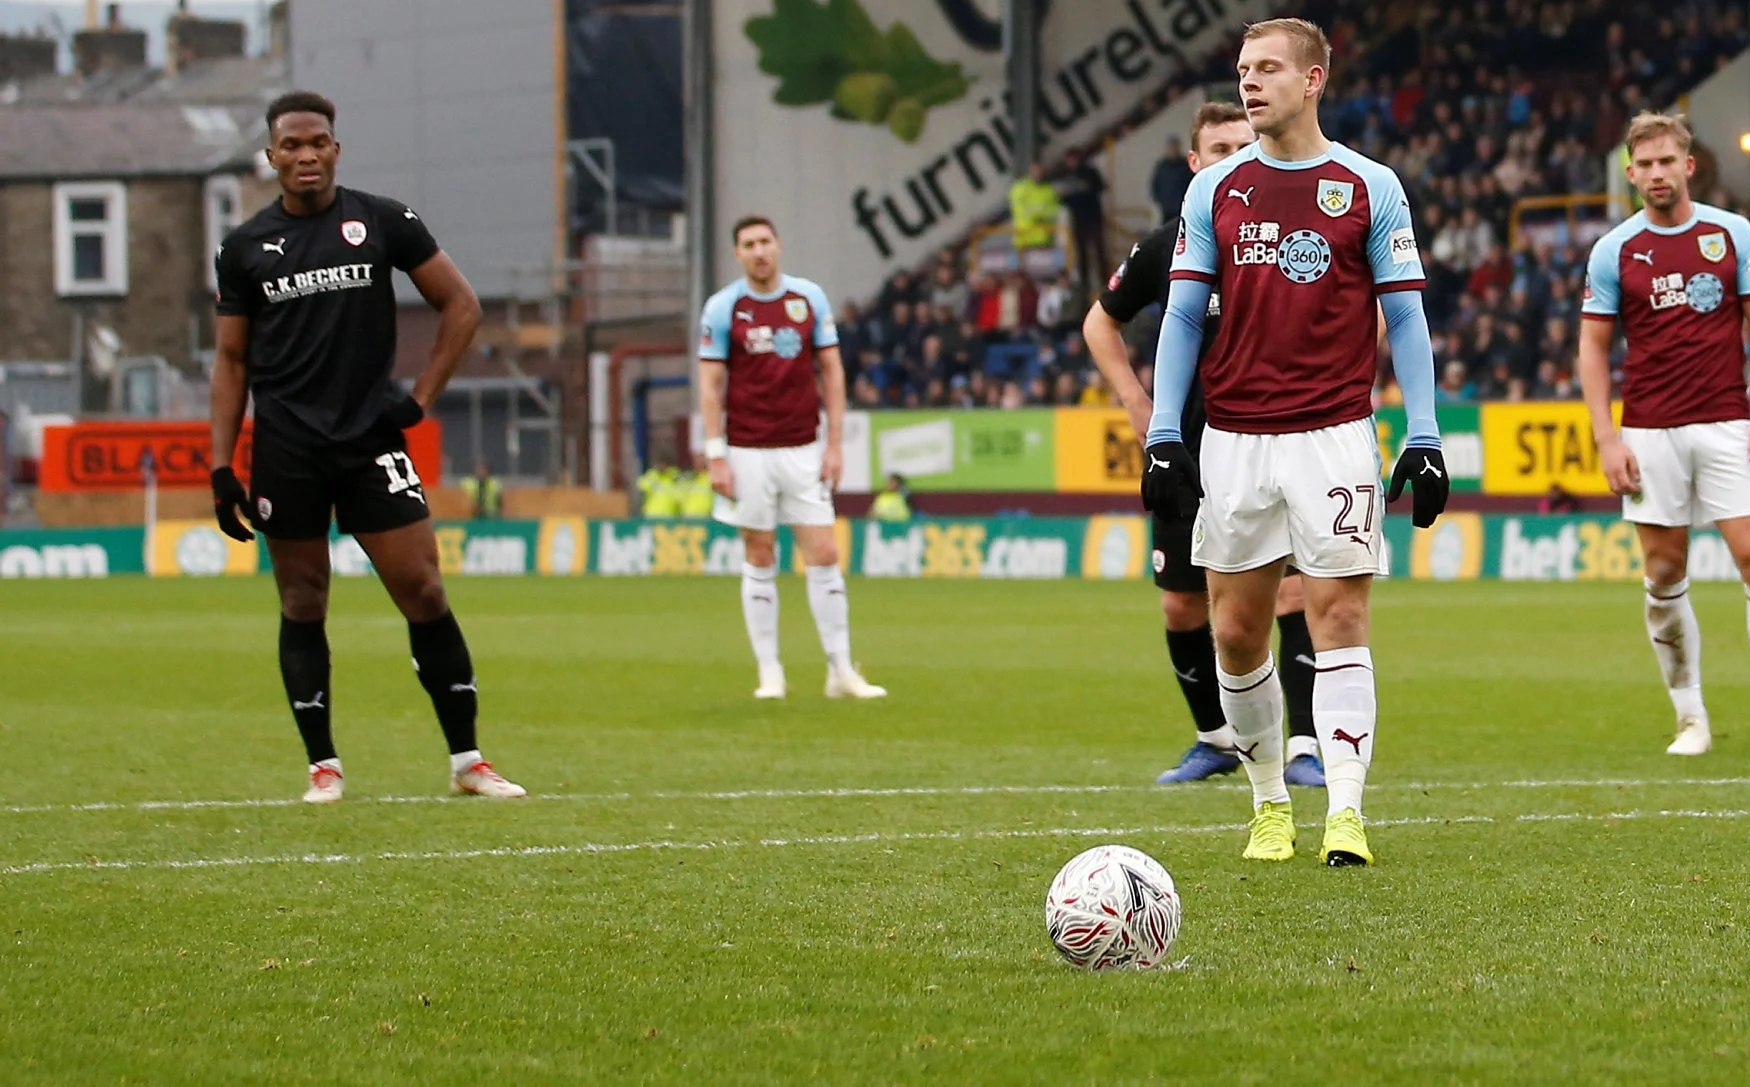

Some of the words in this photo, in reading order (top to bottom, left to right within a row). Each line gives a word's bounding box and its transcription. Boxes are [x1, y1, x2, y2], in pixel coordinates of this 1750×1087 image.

[1233, 244, 1278, 266] LaBa
[1289, 248, 1319, 265] 360
[1650, 290, 1688, 311] LaBa
[1516, 420, 1598, 476] STA
[1327, 484, 1375, 536] 27
[862, 520, 1067, 579] bet365.com
